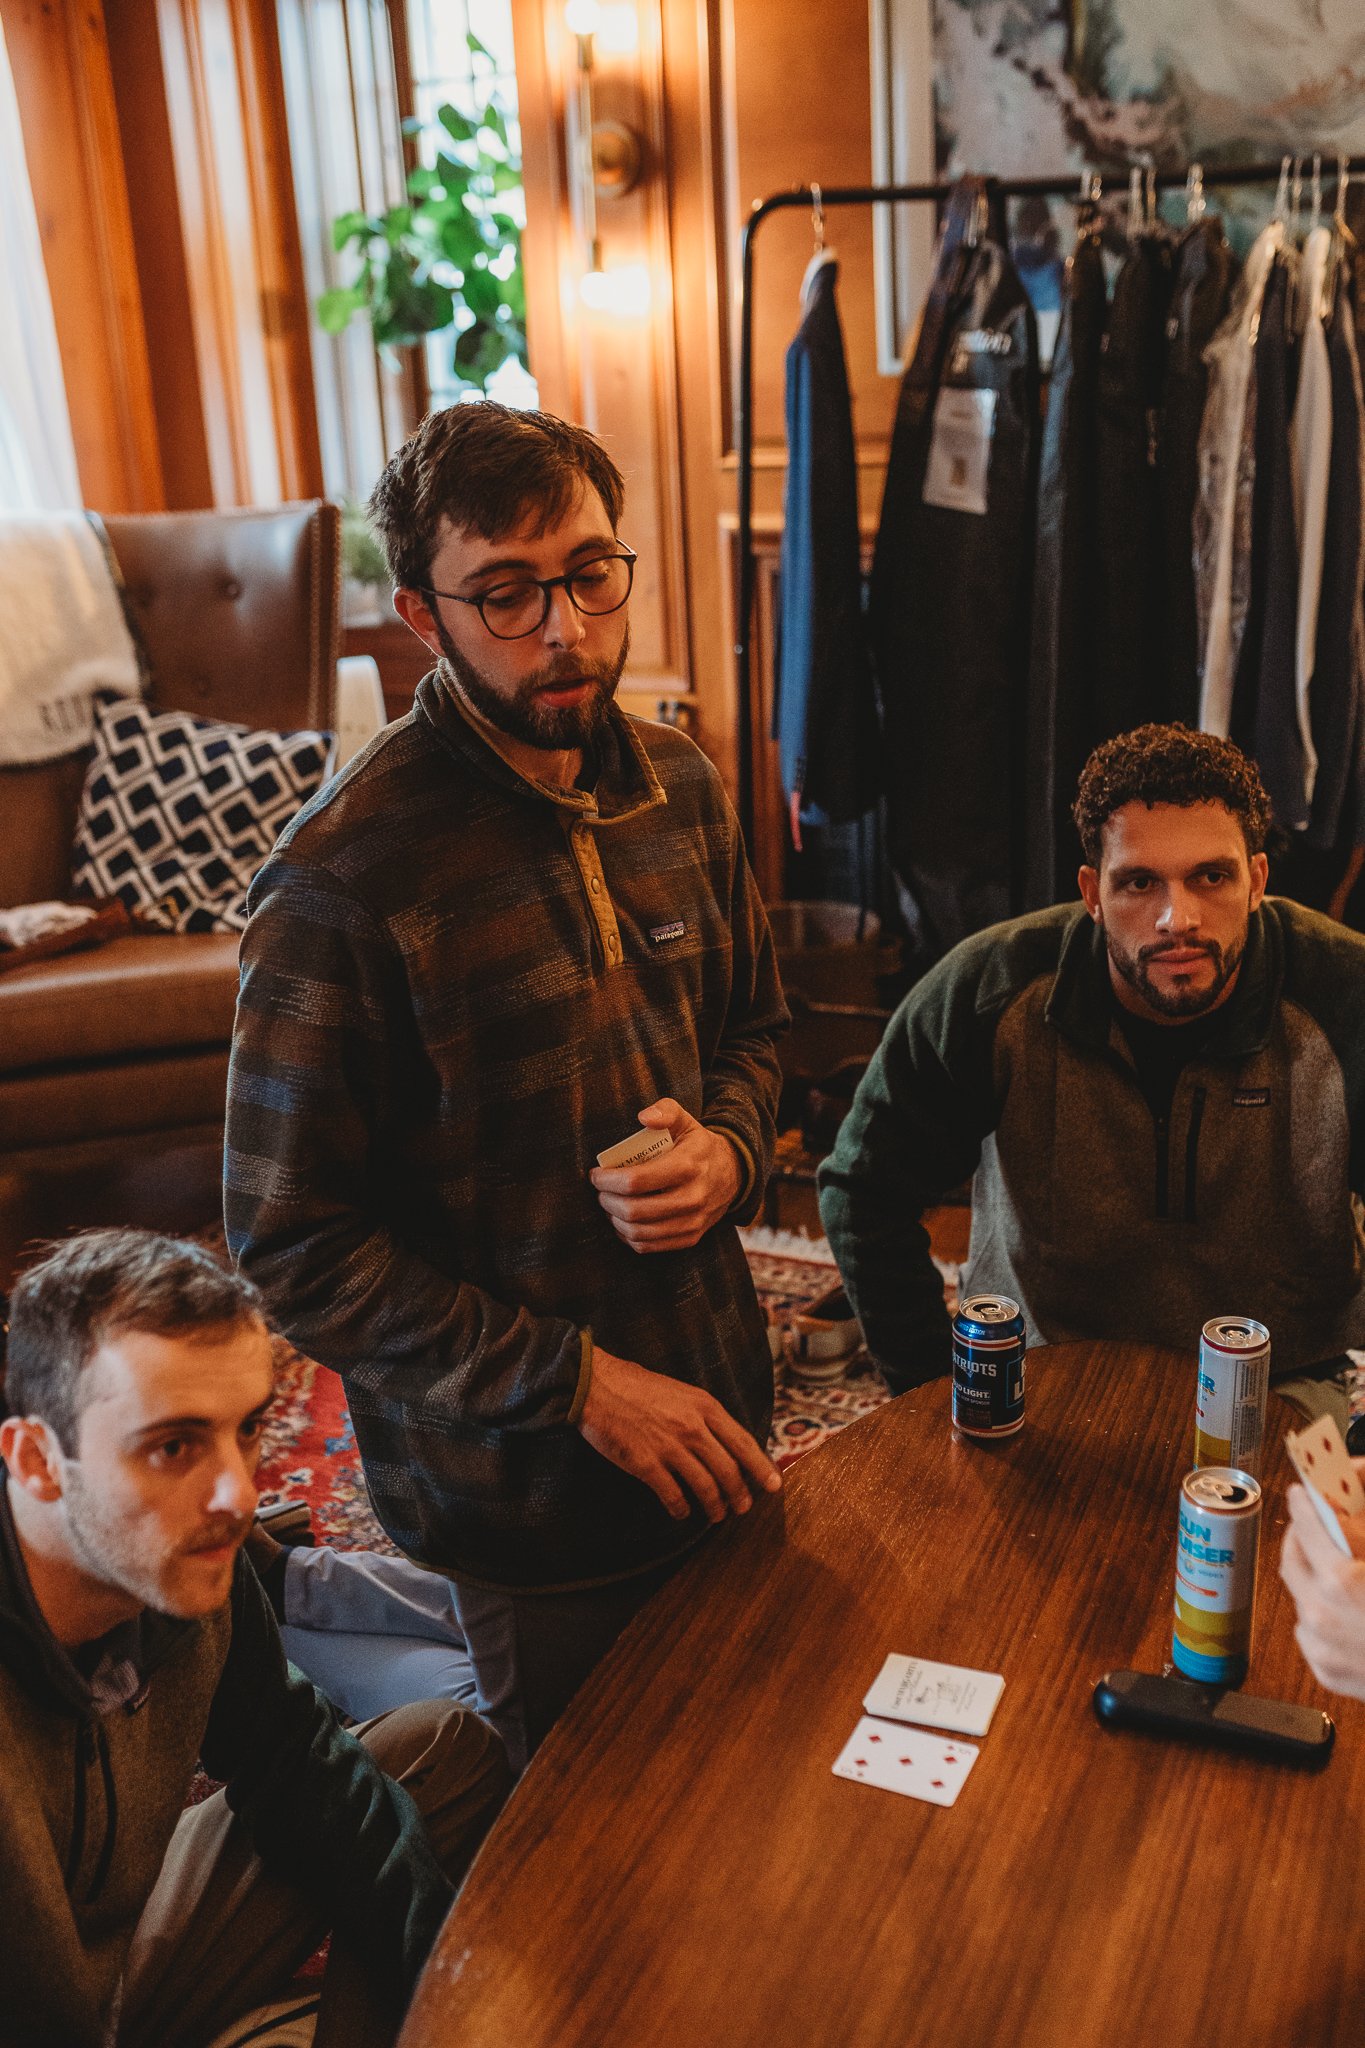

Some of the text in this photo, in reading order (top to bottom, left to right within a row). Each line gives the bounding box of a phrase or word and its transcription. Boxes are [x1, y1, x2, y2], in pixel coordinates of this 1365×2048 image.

[626, 1137, 669, 1165] MARGARITA
[953, 1350, 997, 1377] ATRIOTS
[1178, 1530, 1235, 1563] UISER
